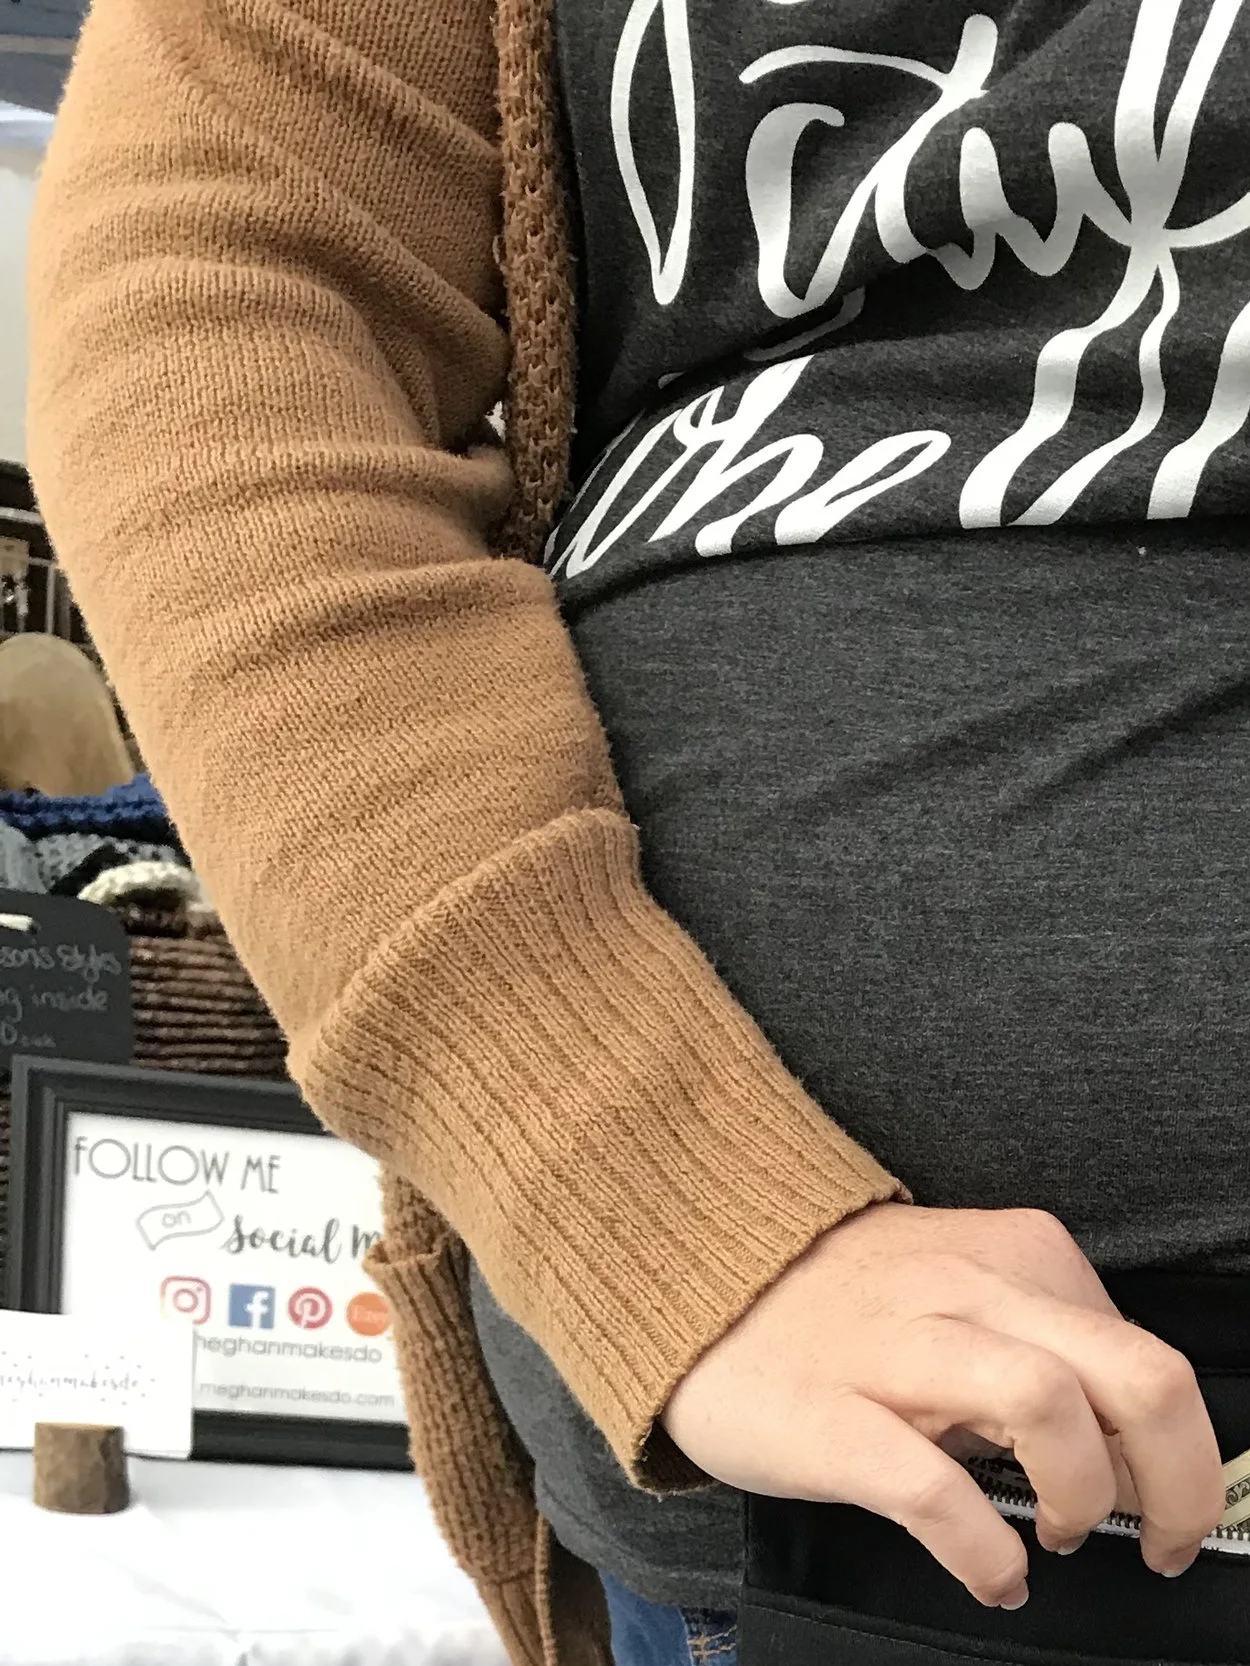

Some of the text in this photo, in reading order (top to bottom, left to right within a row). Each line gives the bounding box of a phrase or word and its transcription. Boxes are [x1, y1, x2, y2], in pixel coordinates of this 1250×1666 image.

[73, 1135, 282, 1195] FOLLOW ME
[162, 1211, 192, 1229] on
[200, 1382, 396, 1408] meghanmakesdo.com
